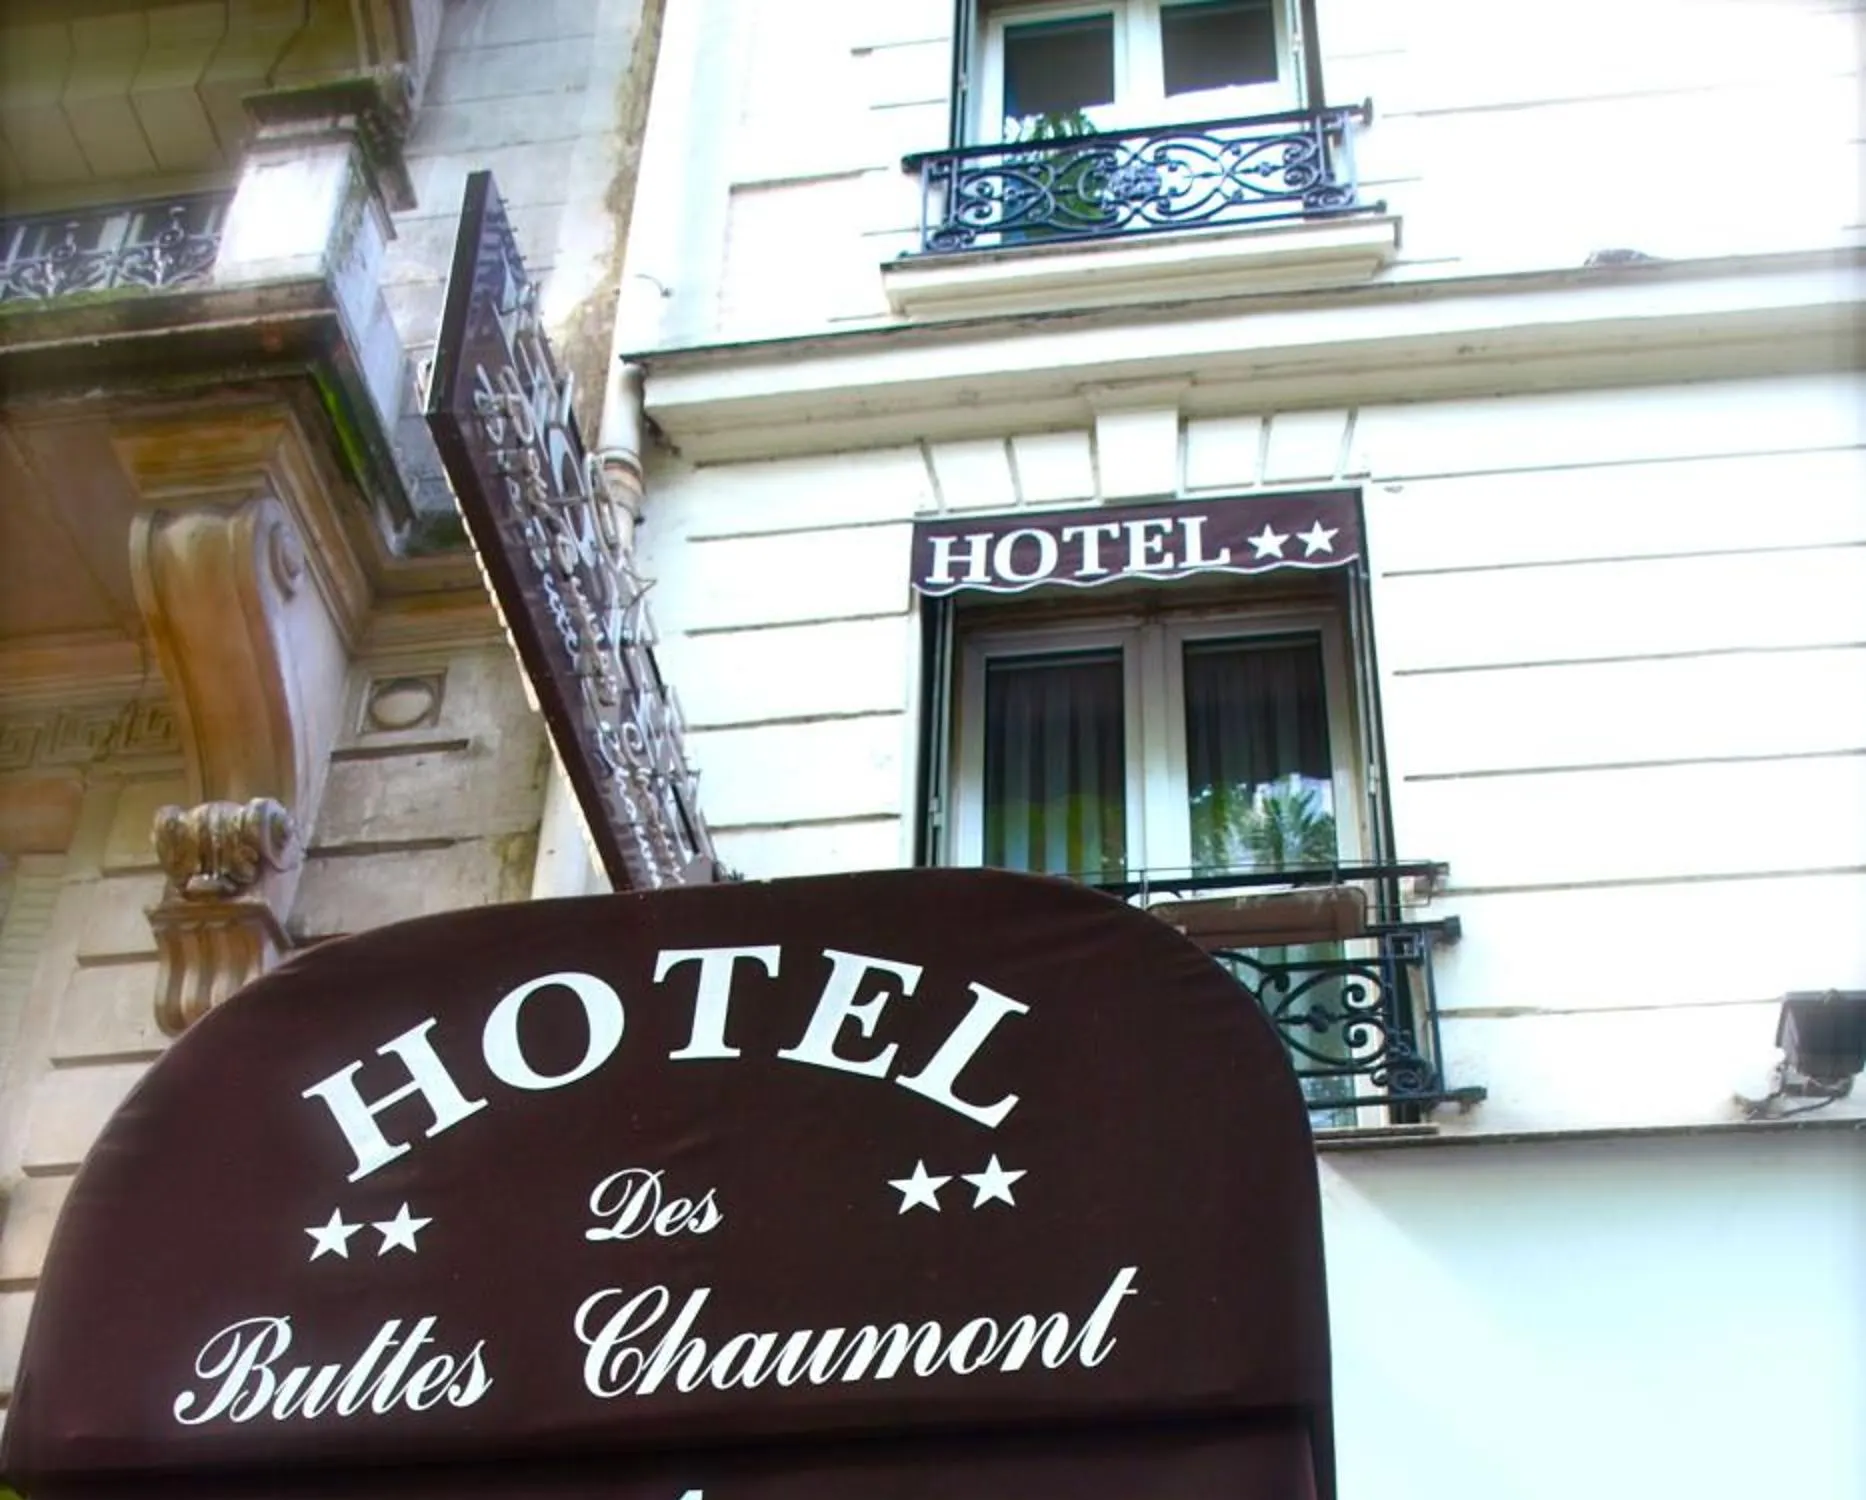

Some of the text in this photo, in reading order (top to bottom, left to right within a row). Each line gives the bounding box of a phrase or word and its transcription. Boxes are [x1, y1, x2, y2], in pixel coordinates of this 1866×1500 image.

[924, 515, 1231, 583] HOTEL
[302, 944, 1030, 1183] HOTEL
[585, 1167, 723, 1242] Des
[172, 1265, 1138, 1426] Buttes Chaumont
